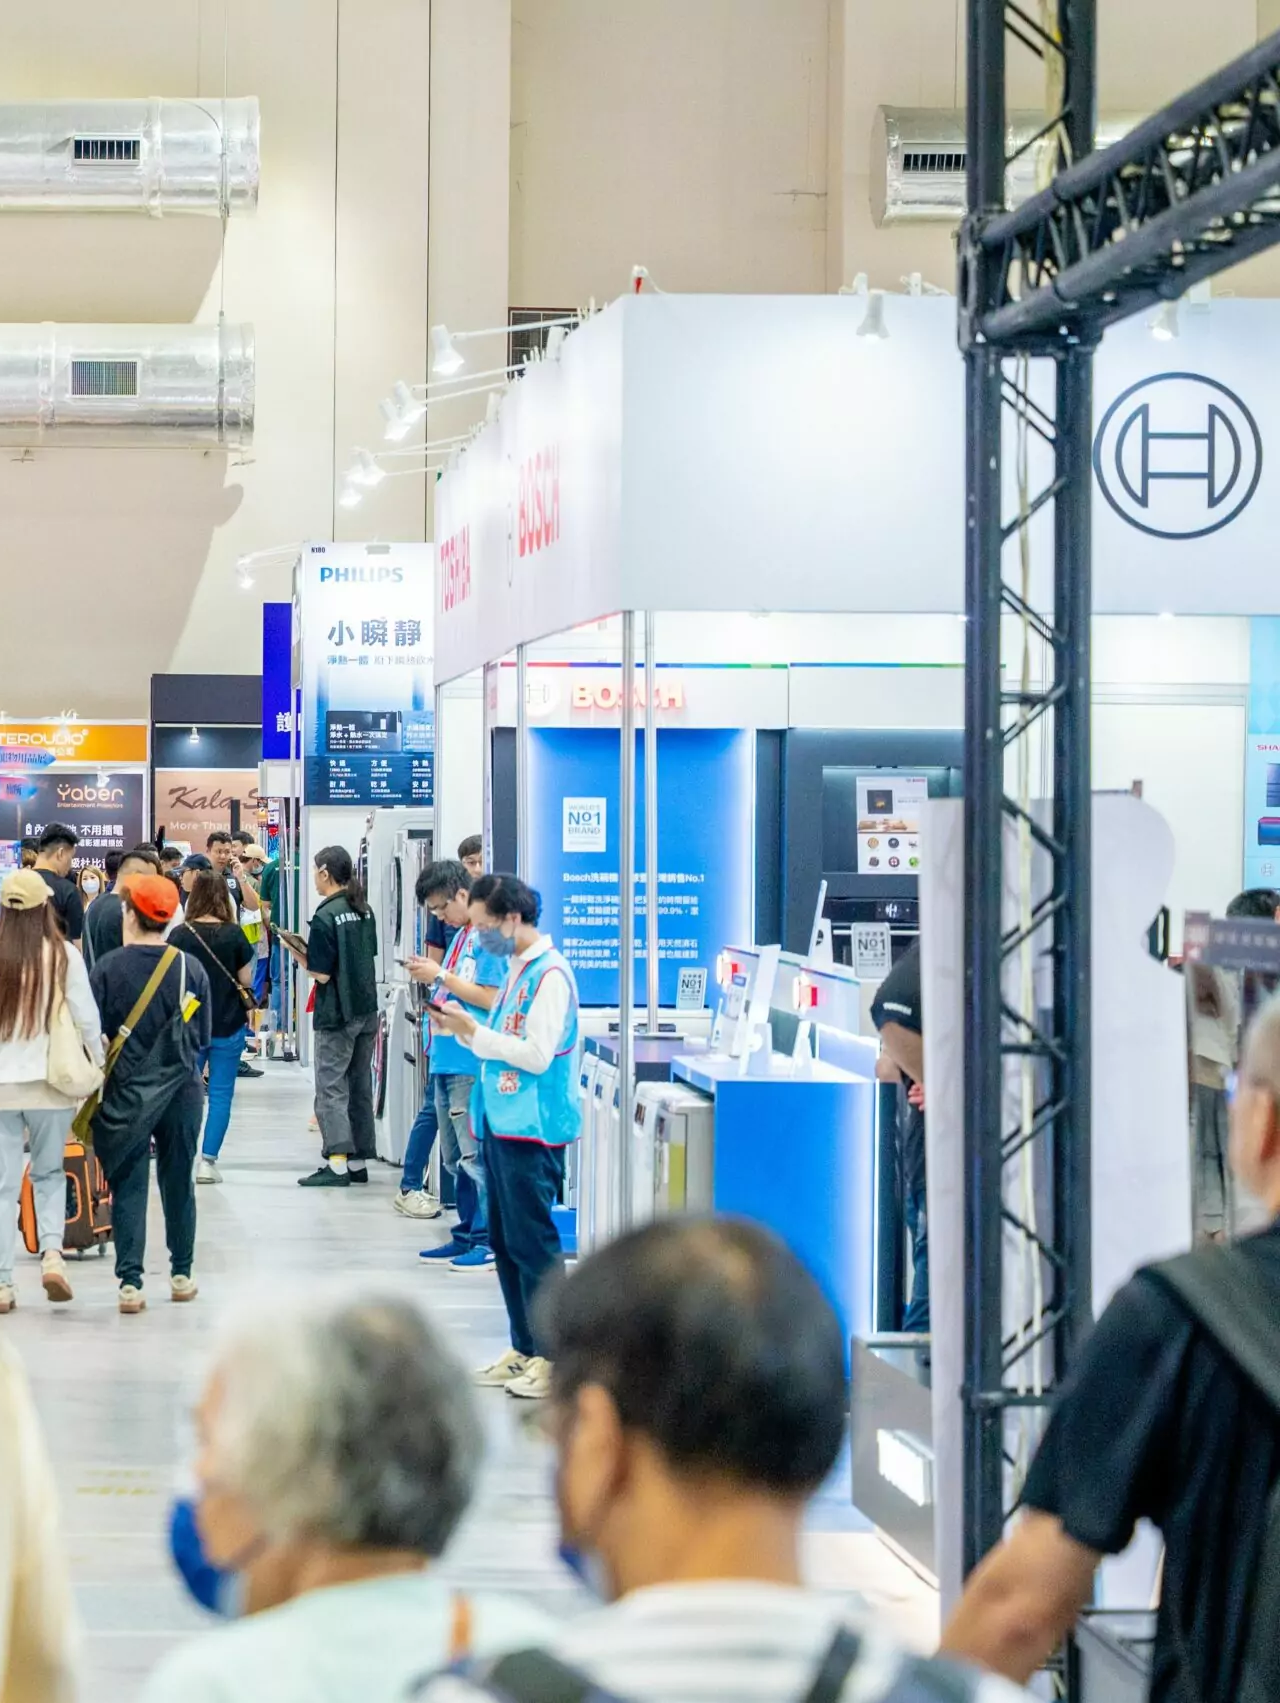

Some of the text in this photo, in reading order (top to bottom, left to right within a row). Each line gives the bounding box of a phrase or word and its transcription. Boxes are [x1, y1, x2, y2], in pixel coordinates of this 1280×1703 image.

[519, 443, 560, 557] BOSCH
[320, 567, 403, 582] PHILIPS
[327, 619, 421, 647] 小瞬靜
[57, 784, 124, 801] Yaber
[81, 824, 124, 836] 不用插電
[170, 822, 199, 830] More
[202, 822, 230, 830] Than
